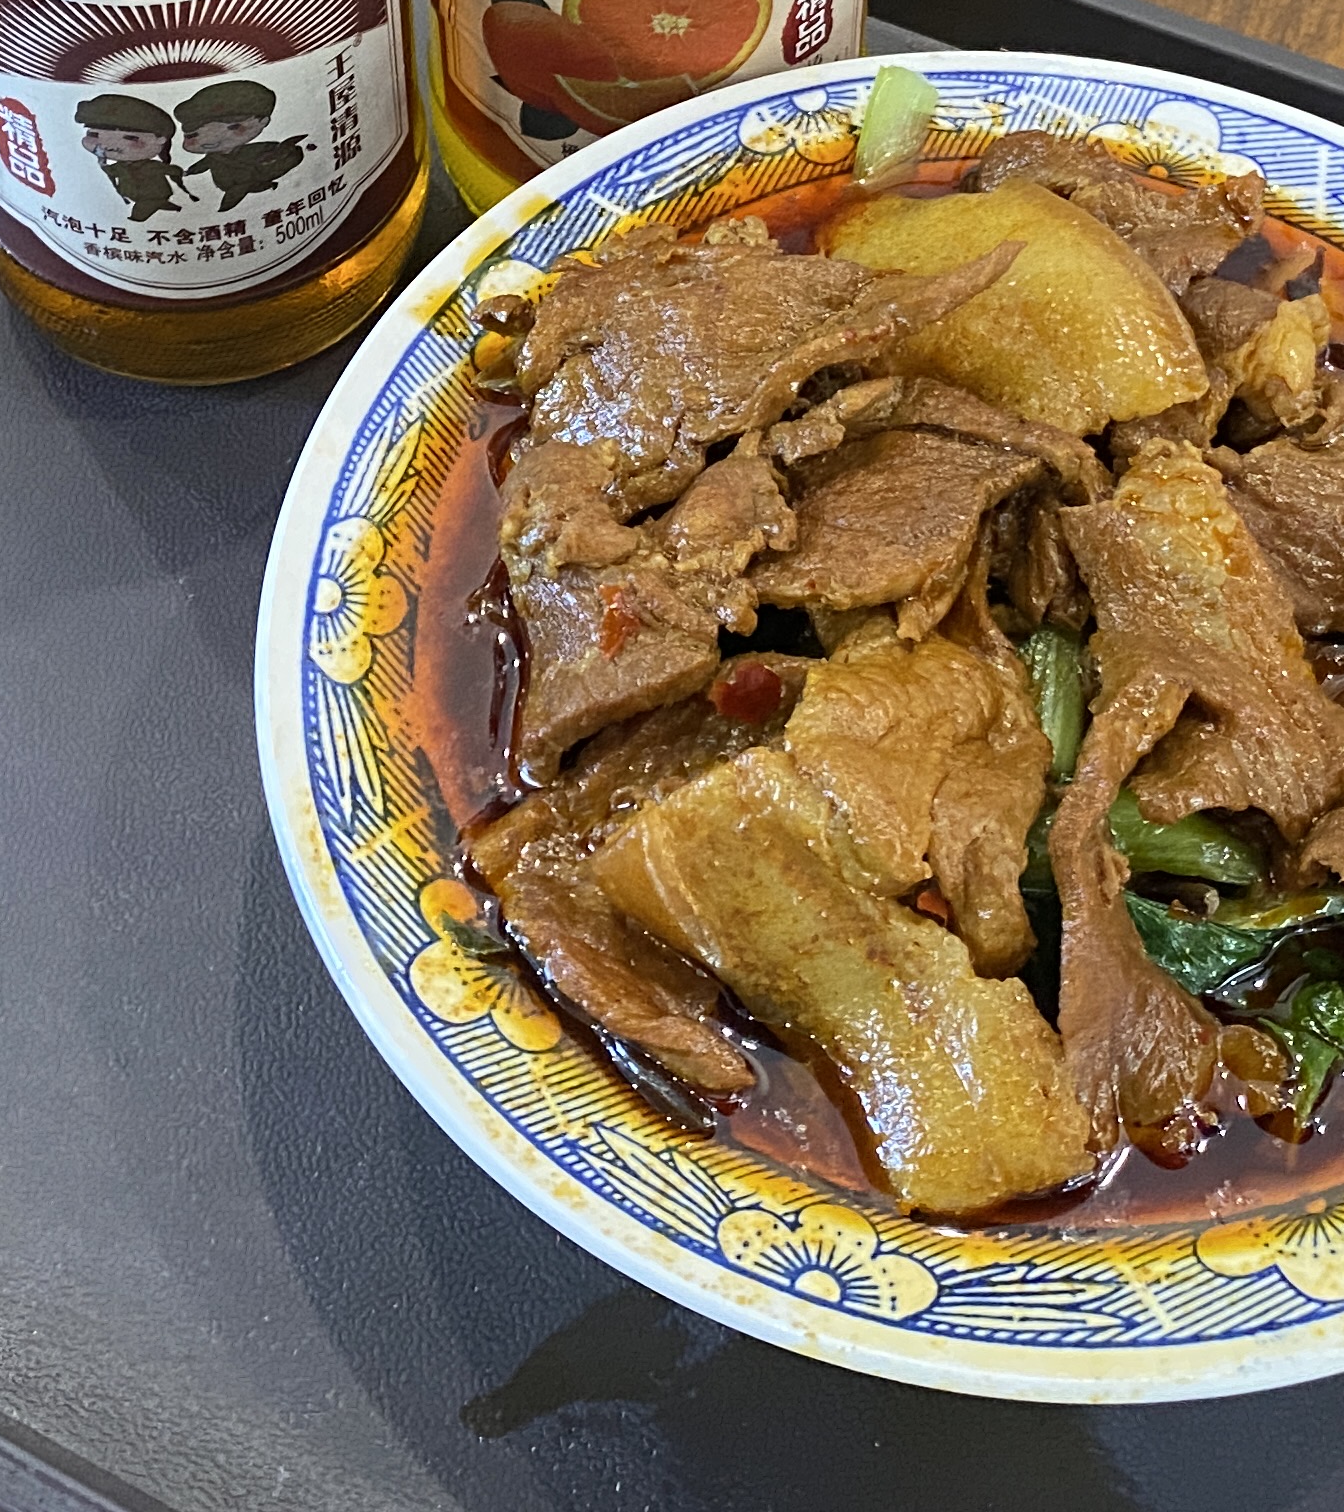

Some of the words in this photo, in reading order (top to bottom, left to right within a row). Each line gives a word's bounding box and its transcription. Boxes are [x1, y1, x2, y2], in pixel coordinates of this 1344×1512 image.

[324, 44, 362, 171] 王屋清源
[147, 219, 247, 246] 不含酒精
[261, 173, 348, 229] 童年回忆
